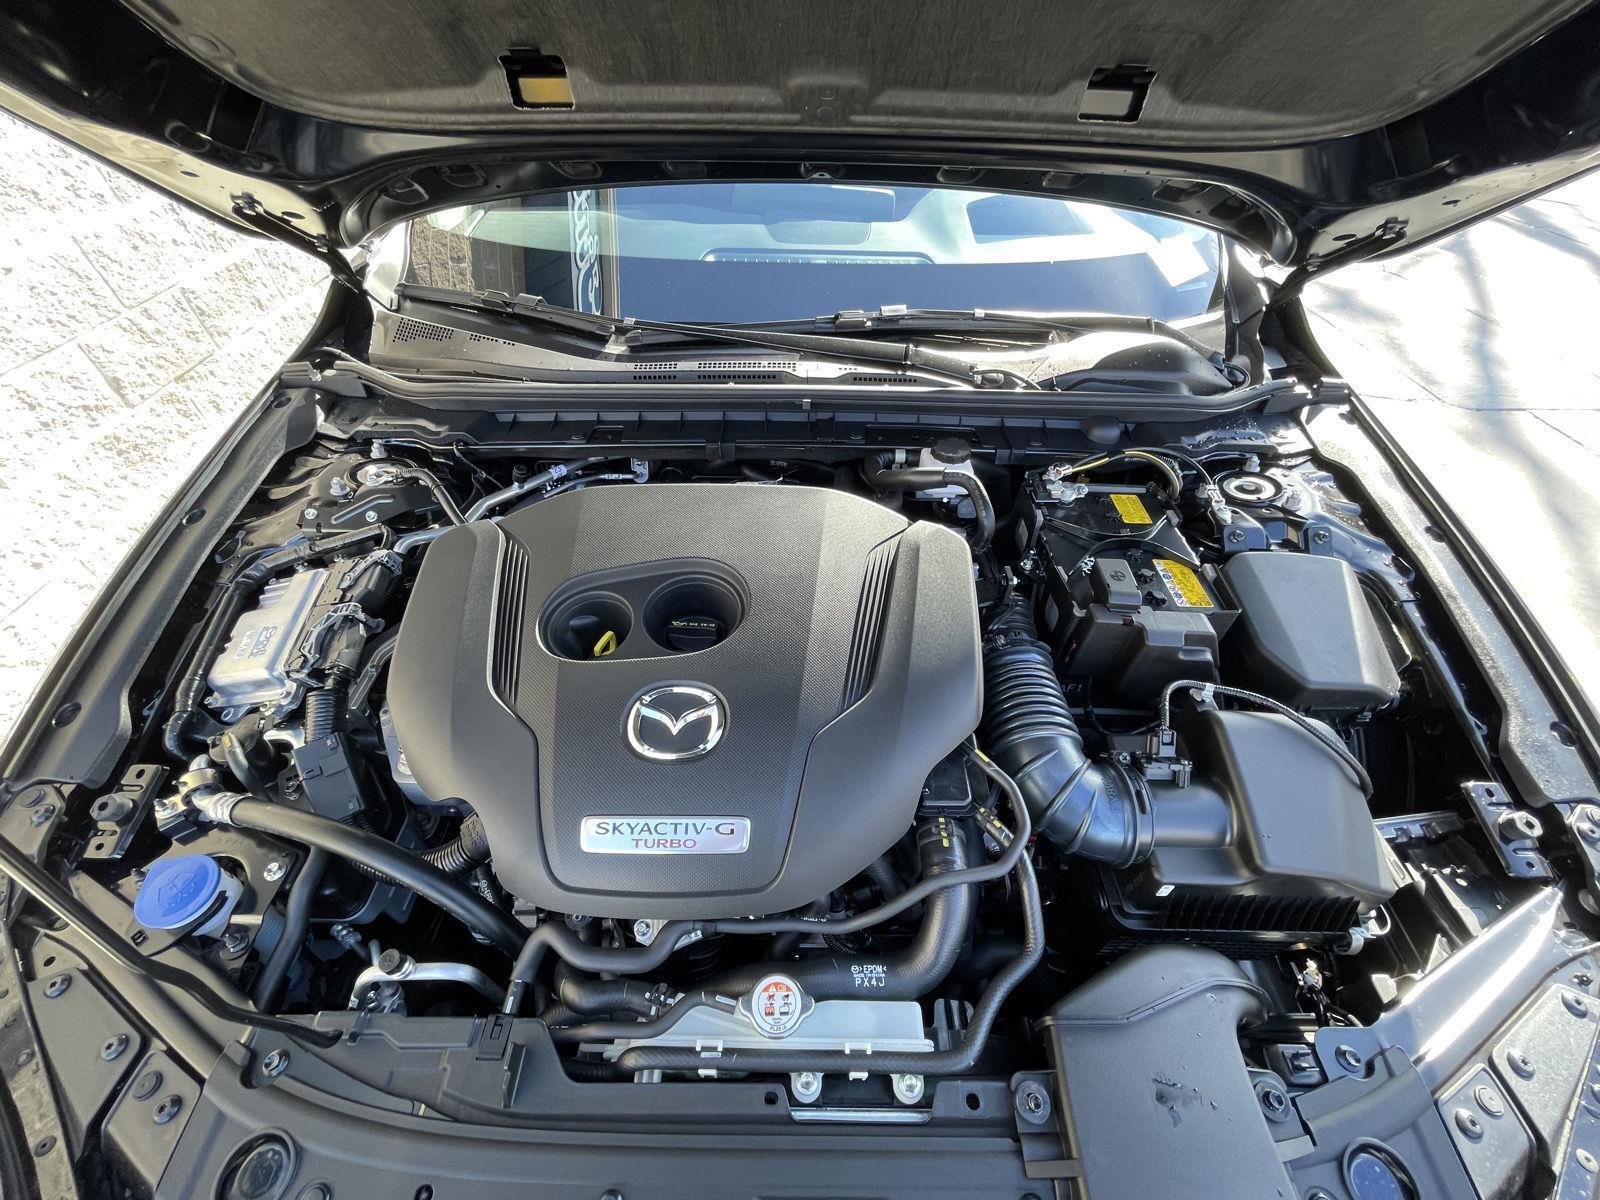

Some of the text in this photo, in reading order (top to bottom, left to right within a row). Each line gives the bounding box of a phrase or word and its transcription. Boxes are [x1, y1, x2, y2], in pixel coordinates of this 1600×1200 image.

[595, 822, 735, 836] SKYACTIV-G
[631, 838, 697, 849] TURBO
[855, 977, 885, 987] PX4J
